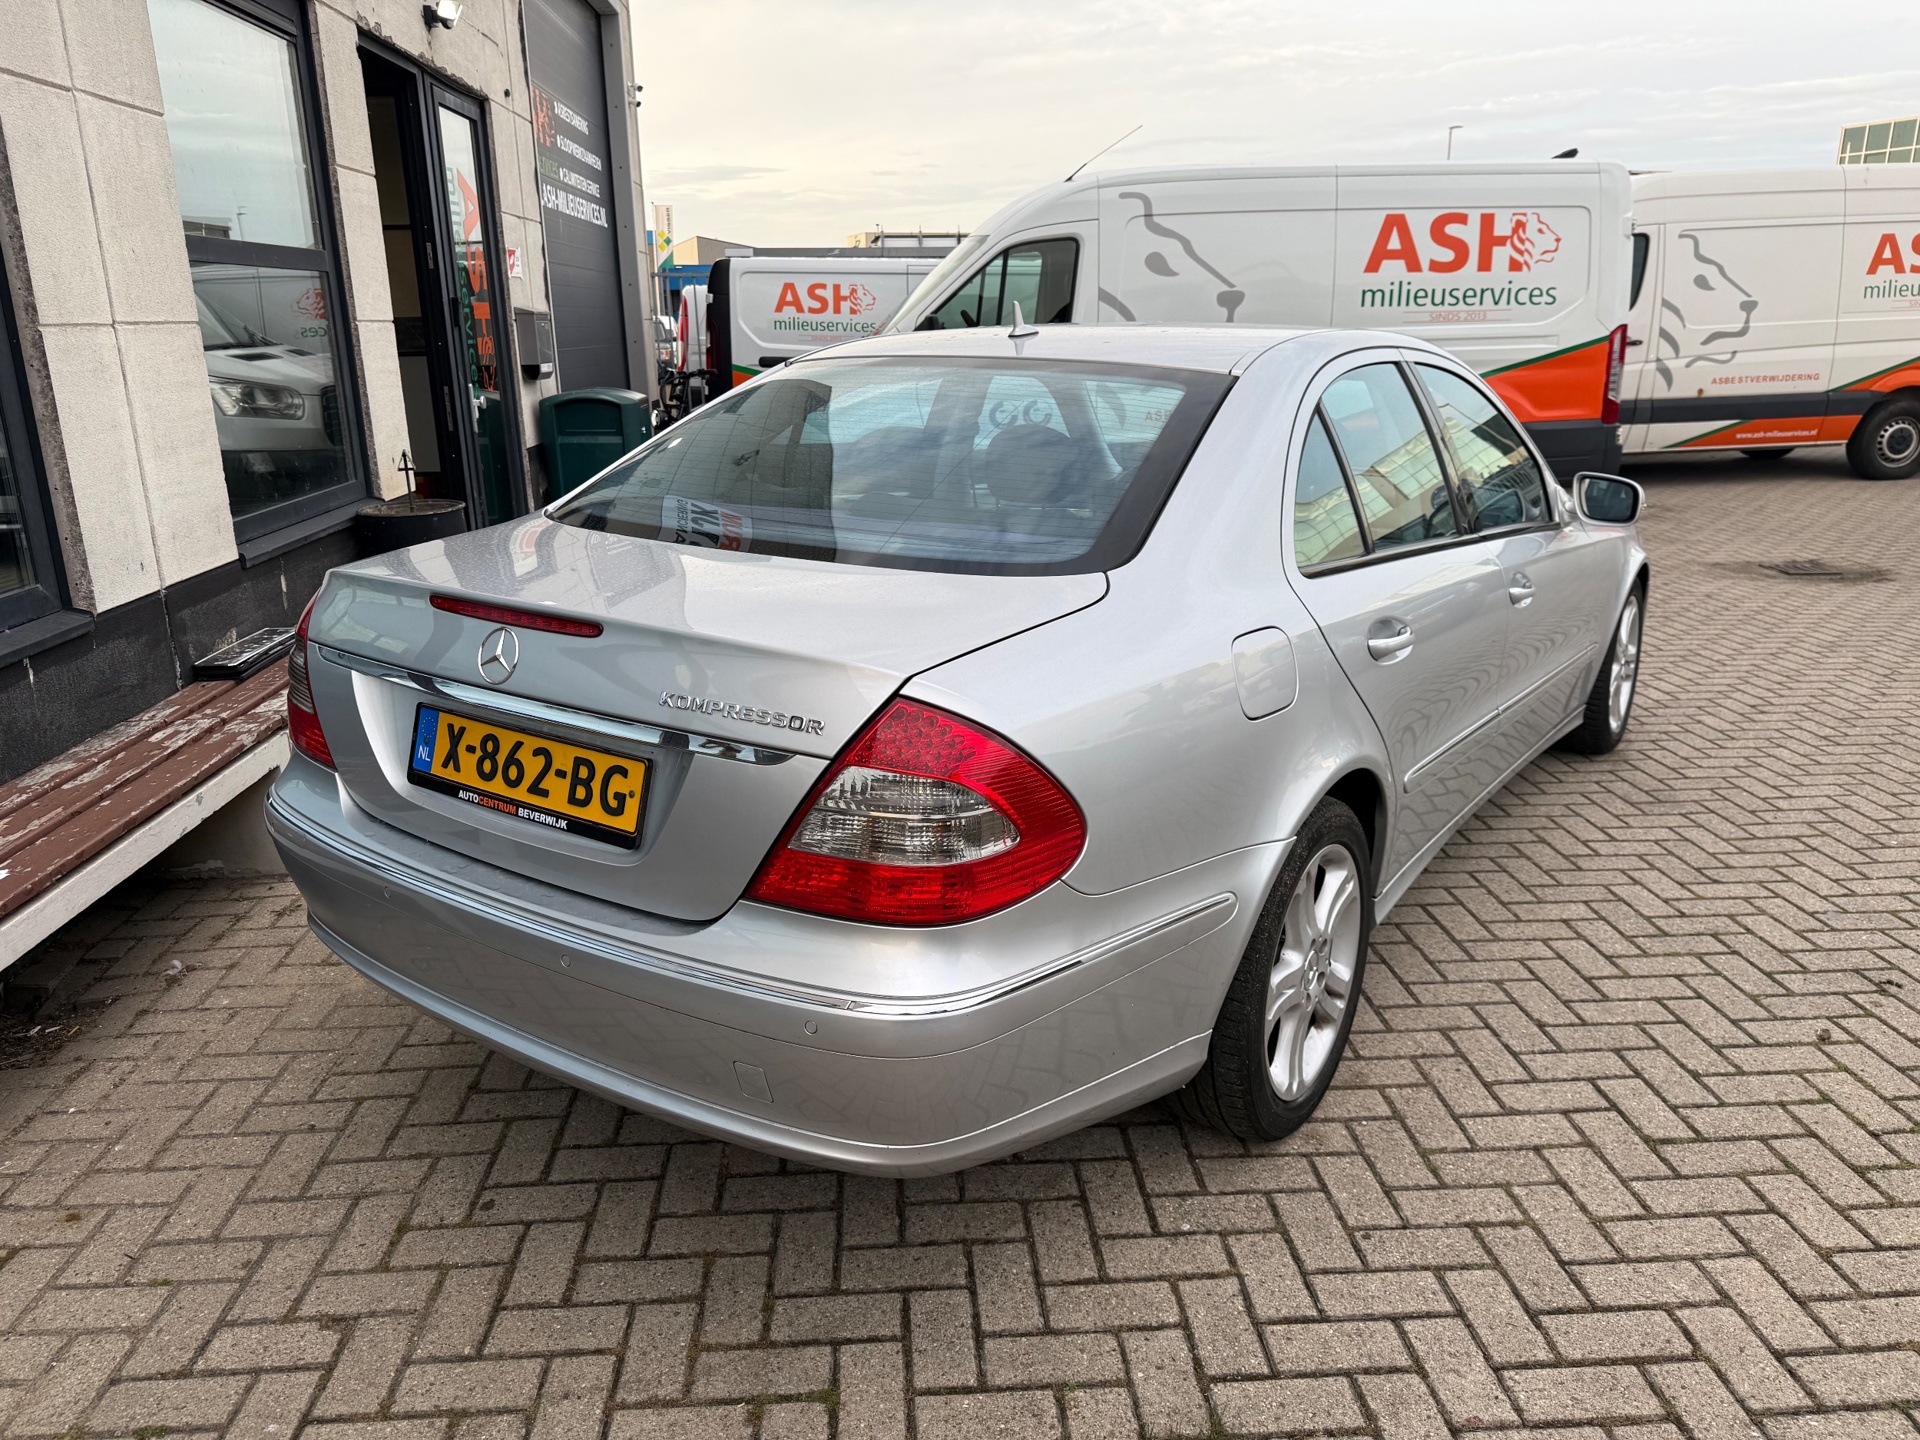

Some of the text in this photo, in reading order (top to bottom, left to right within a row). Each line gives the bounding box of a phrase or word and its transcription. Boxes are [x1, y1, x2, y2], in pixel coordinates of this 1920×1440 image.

[1363, 212, 1530, 273] ASH
[774, 282, 862, 315] ASH
[1361, 280, 1557, 308] milieuservices
[774, 316, 876, 334] milieuservices
[1429, 311, 1487, 322] SINDS 2013
[1711, 373, 1820, 385] ASBESTVERWIJDERING
[1735, 428, 1818, 439] www.ash-milieuservices.nl
[659, 690, 826, 736] KOMPRESSOR
[418, 745, 431, 762] NL
[440, 722, 629, 817] X-862-BG
[458, 789, 568, 831] AUTOCENTRUM BEVERWIJK
